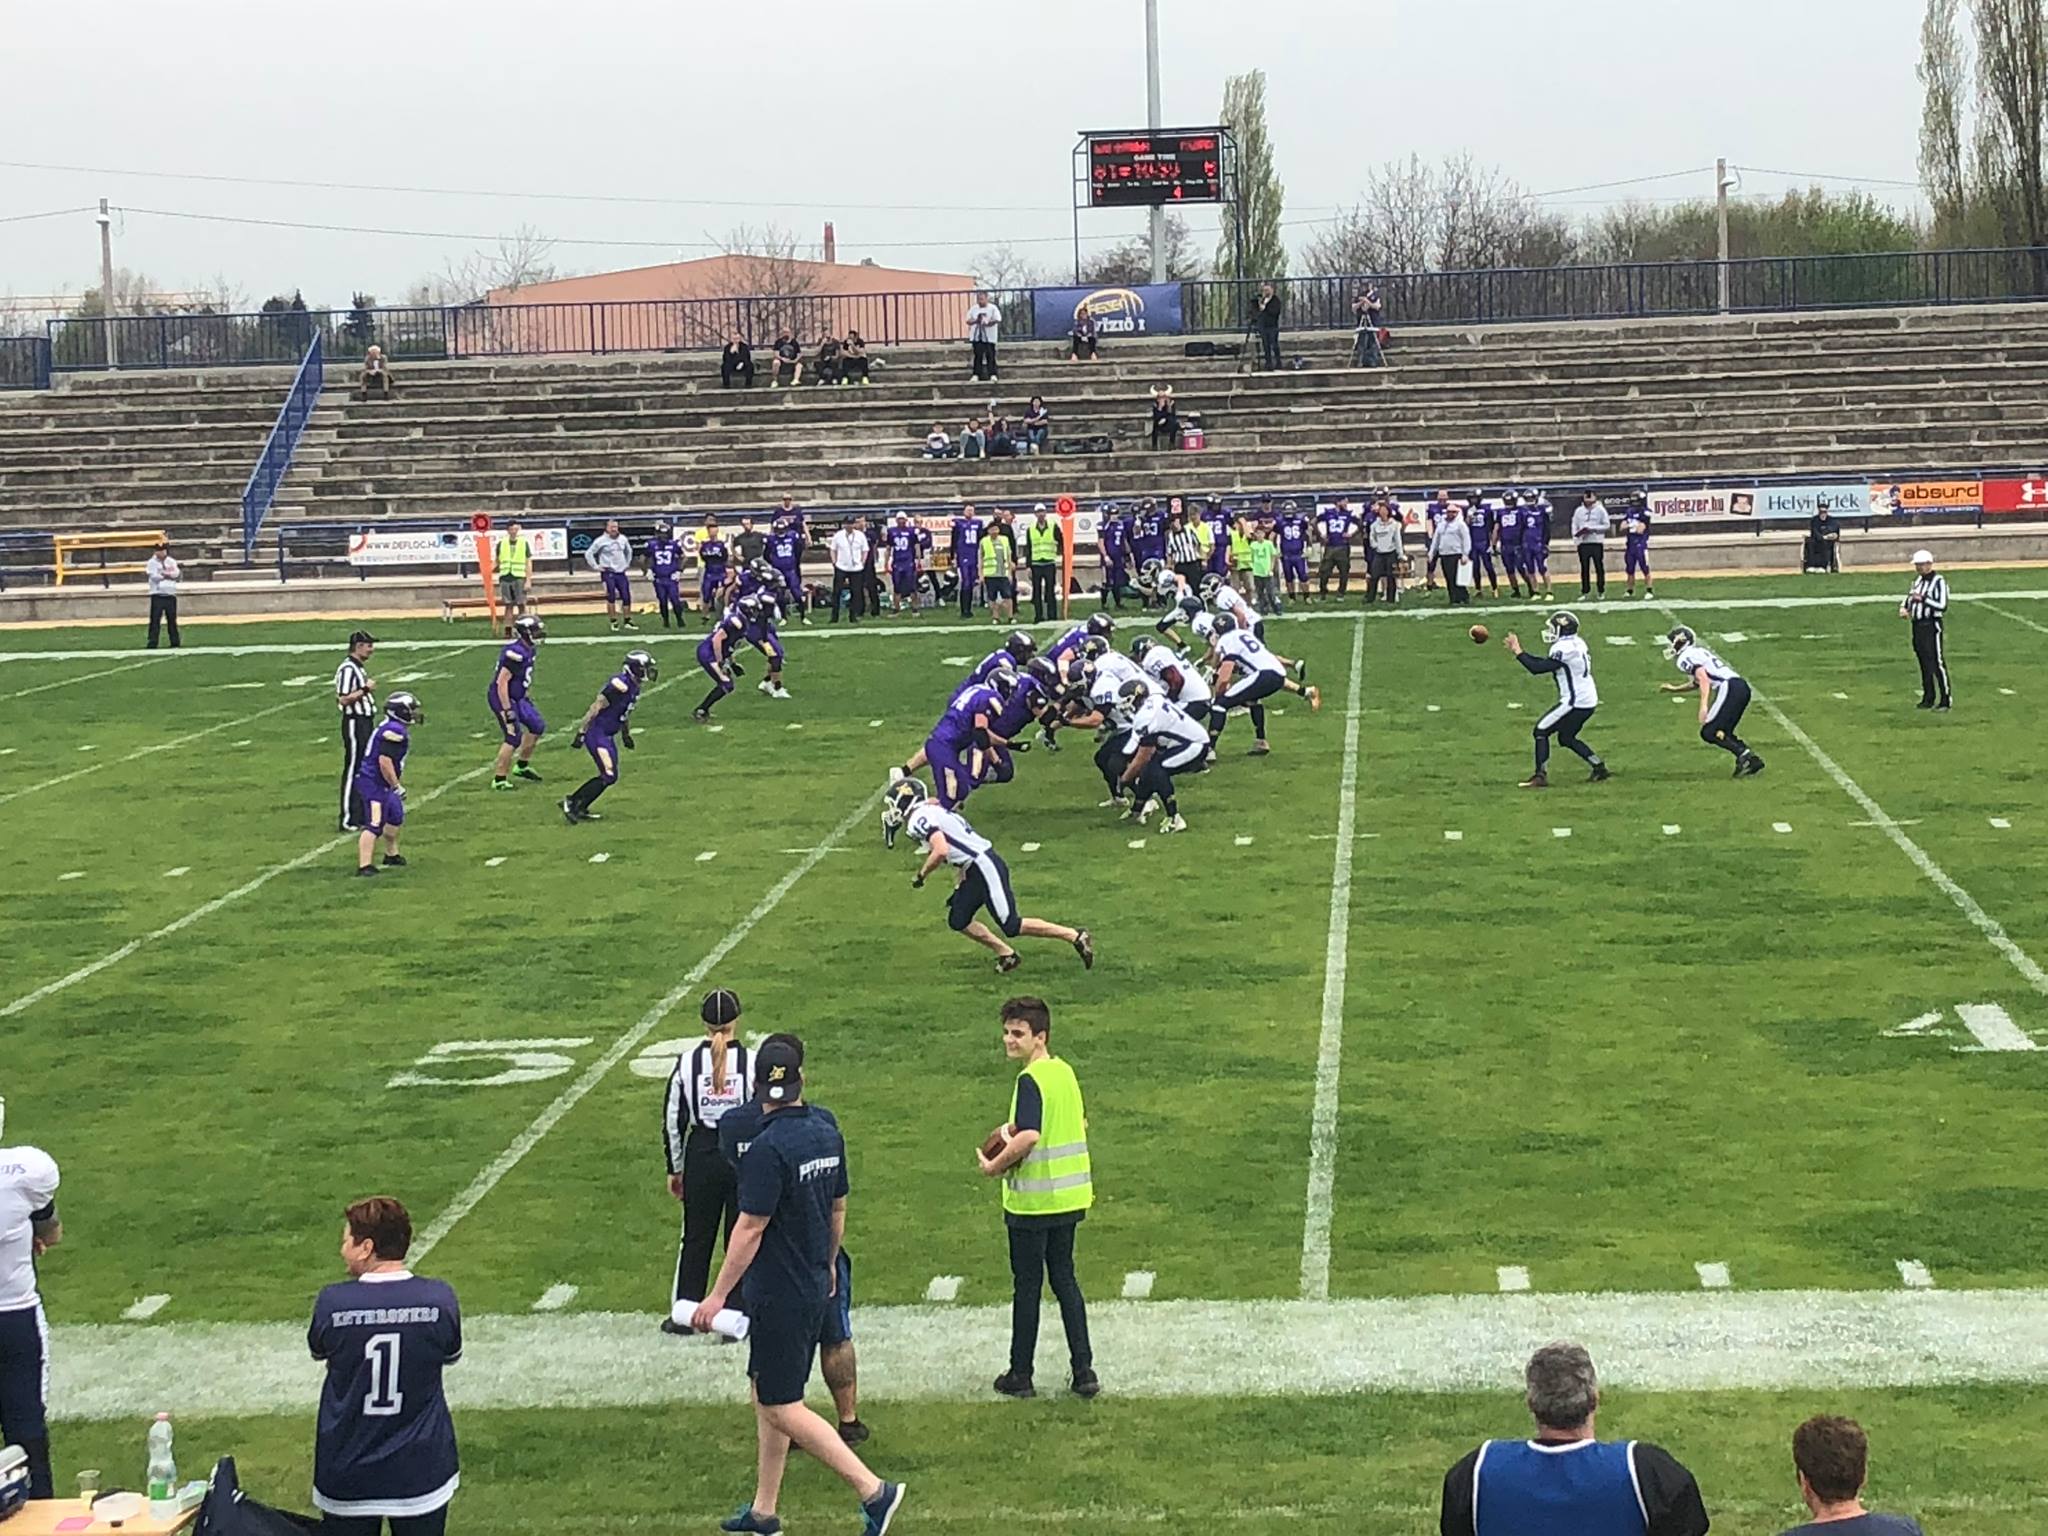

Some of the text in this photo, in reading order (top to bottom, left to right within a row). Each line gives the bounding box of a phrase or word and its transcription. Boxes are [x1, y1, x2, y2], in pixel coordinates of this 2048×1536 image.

[1903, 483, 1979, 499] absurd
[1768, 494, 1810, 512] Helyi
[654, 550, 673, 565] 53
[1239, 633, 1261, 654] 6
[913, 816, 930, 836] 12
[703, 1076, 737, 1087] SRT
[362, 1332, 404, 1416] 1
